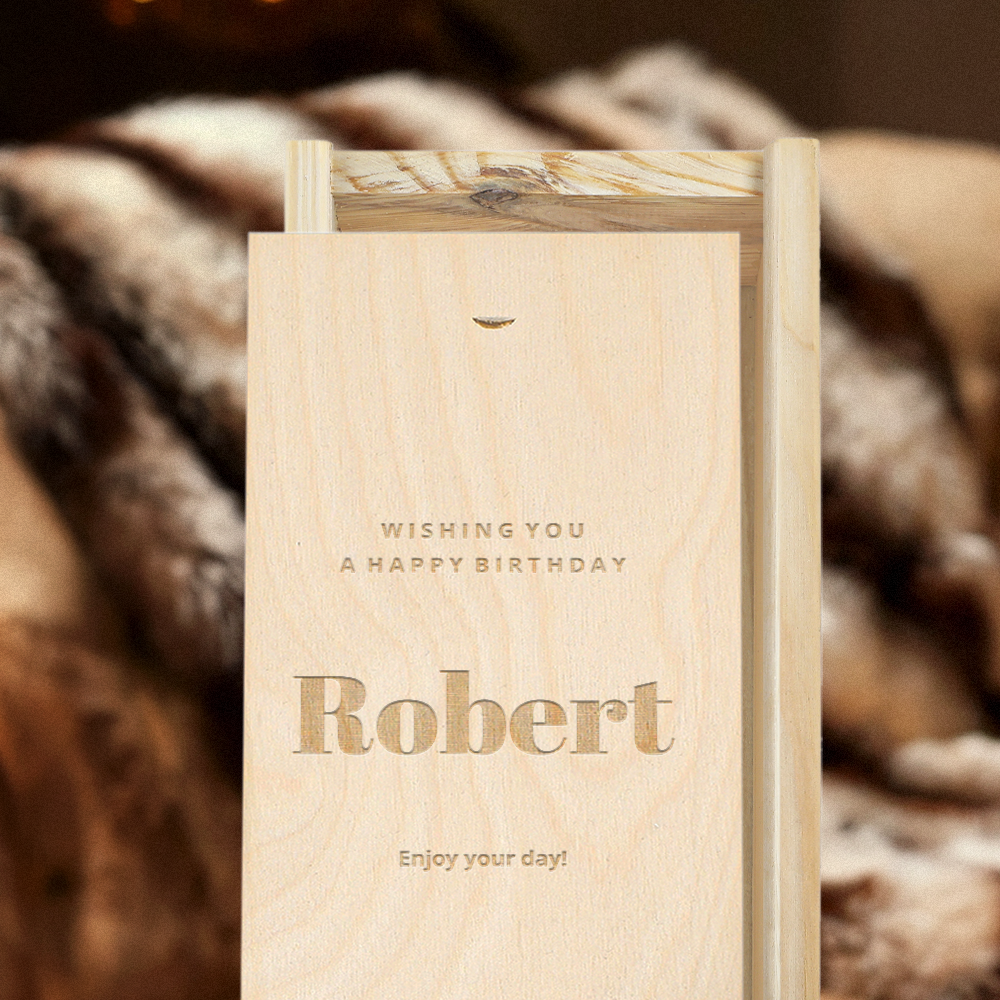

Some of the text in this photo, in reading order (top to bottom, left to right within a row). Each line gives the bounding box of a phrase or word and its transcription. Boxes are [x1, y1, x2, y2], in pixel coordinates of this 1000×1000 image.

[381, 522, 585, 539] WISHING YOU
[340, 557, 627, 573] A HAPPY BIRTHDAY
[293, 669, 675, 756] Robert
[400, 850, 568, 871] Enjoy your day!
